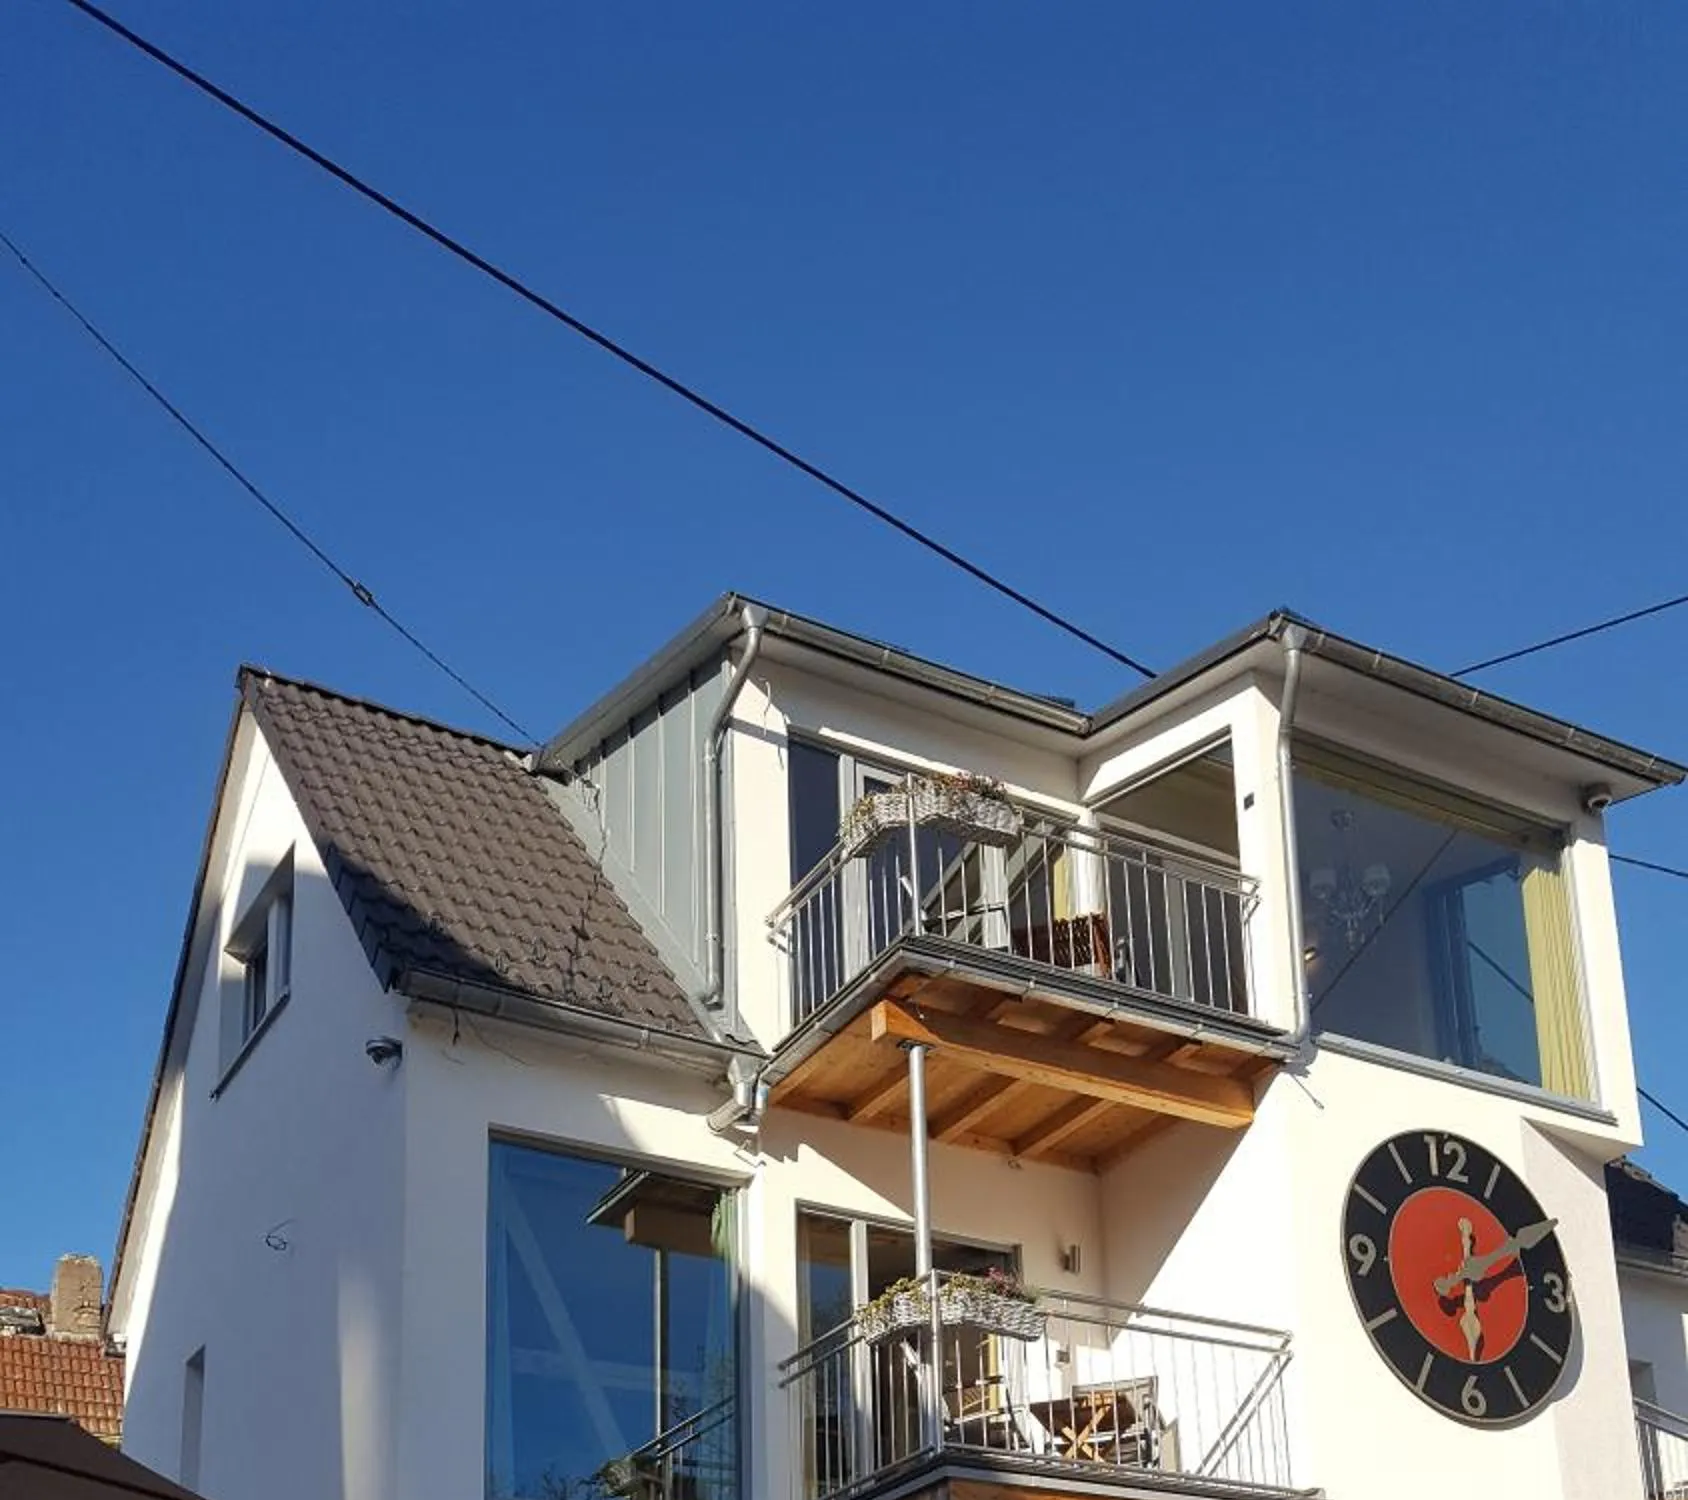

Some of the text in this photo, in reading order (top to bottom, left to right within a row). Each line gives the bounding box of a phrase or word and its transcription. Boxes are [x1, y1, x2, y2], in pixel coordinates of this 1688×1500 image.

[1423, 1135, 1469, 1184] 12
[1349, 1233, 1377, 1276] 9
[1543, 1272, 1567, 1313] 3
[1460, 1375, 1487, 1417] 6
